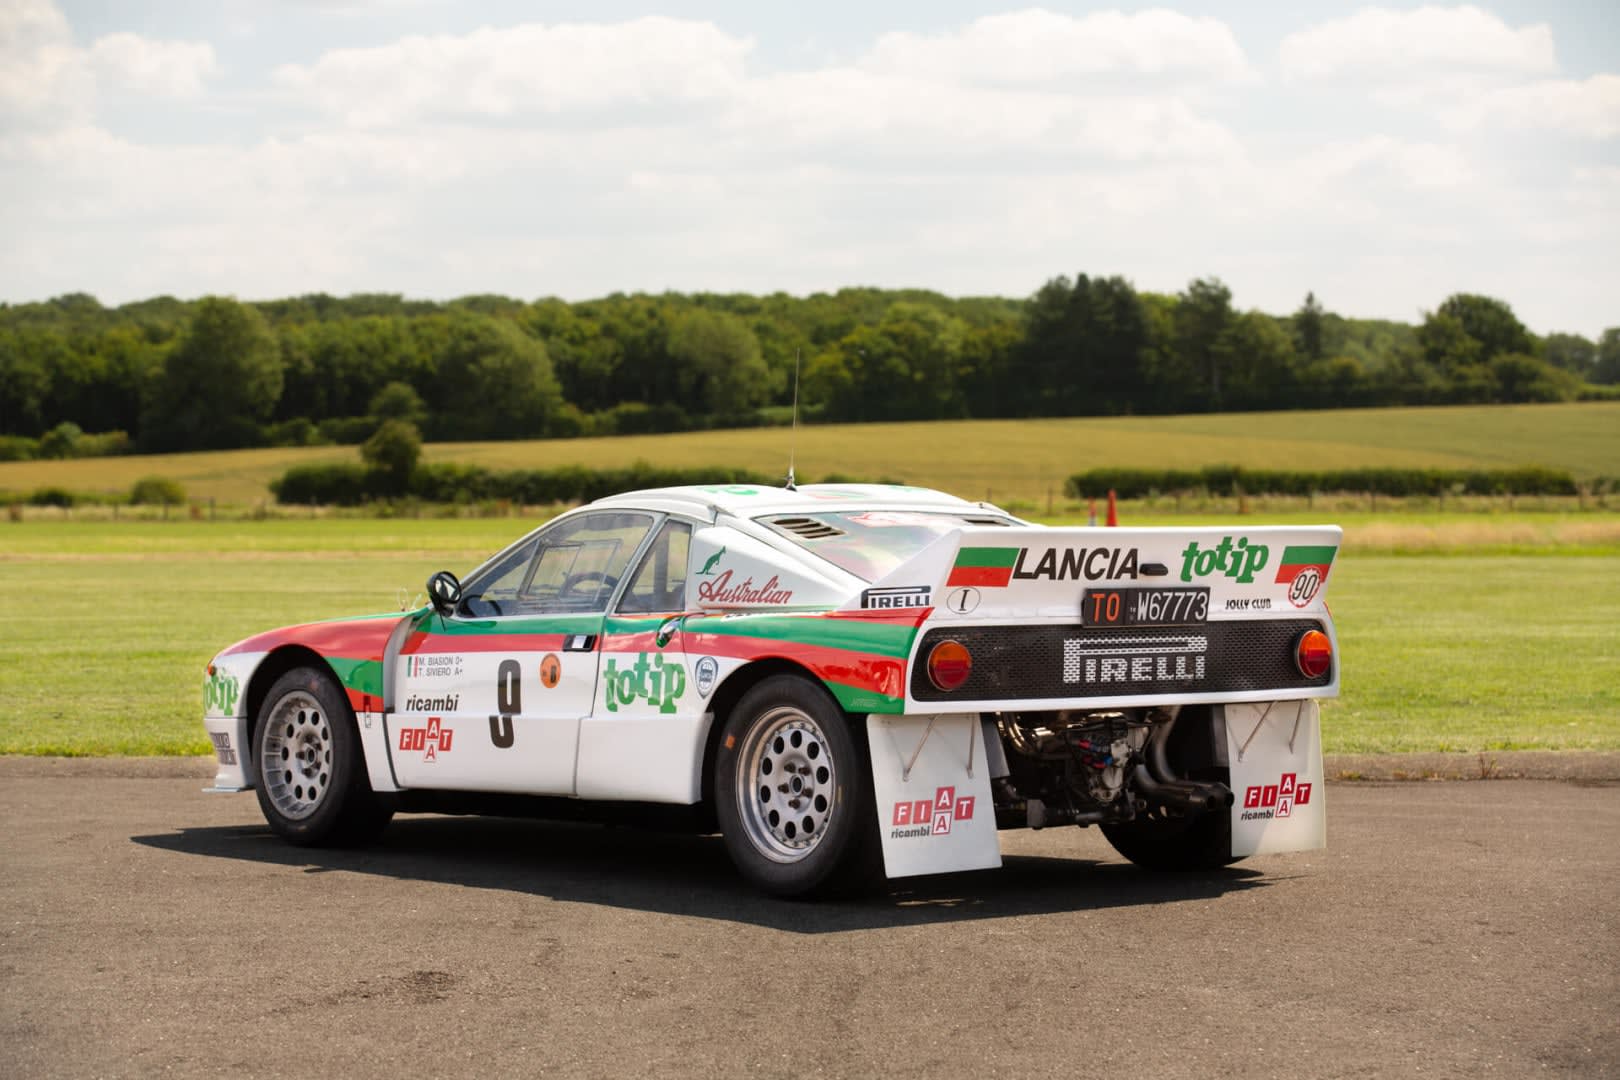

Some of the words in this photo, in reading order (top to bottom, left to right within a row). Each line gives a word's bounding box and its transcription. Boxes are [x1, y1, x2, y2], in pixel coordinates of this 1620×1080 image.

[1012, 547, 1139, 580] LANCIA
[1181, 536, 1270, 583] totip
[698, 569, 793, 605] Australian
[860, 585, 931, 609] PIRELLI
[1291, 573, 1318, 601] 90
[1137, 591, 1208, 621] W67773
[1225, 599, 1249, 610] JOLLY
[1251, 598, 1272, 609] CLUB
[426, 667, 451, 677] SIVIERO
[428, 656, 453, 666] BIASION
[1063, 634, 1208, 685] PIRELLI
[603, 652, 686, 714] totip
[405, 693, 460, 712] ricambi
[1240, 806, 1276, 822] ricambi
[891, 825, 931, 839] ricambi
